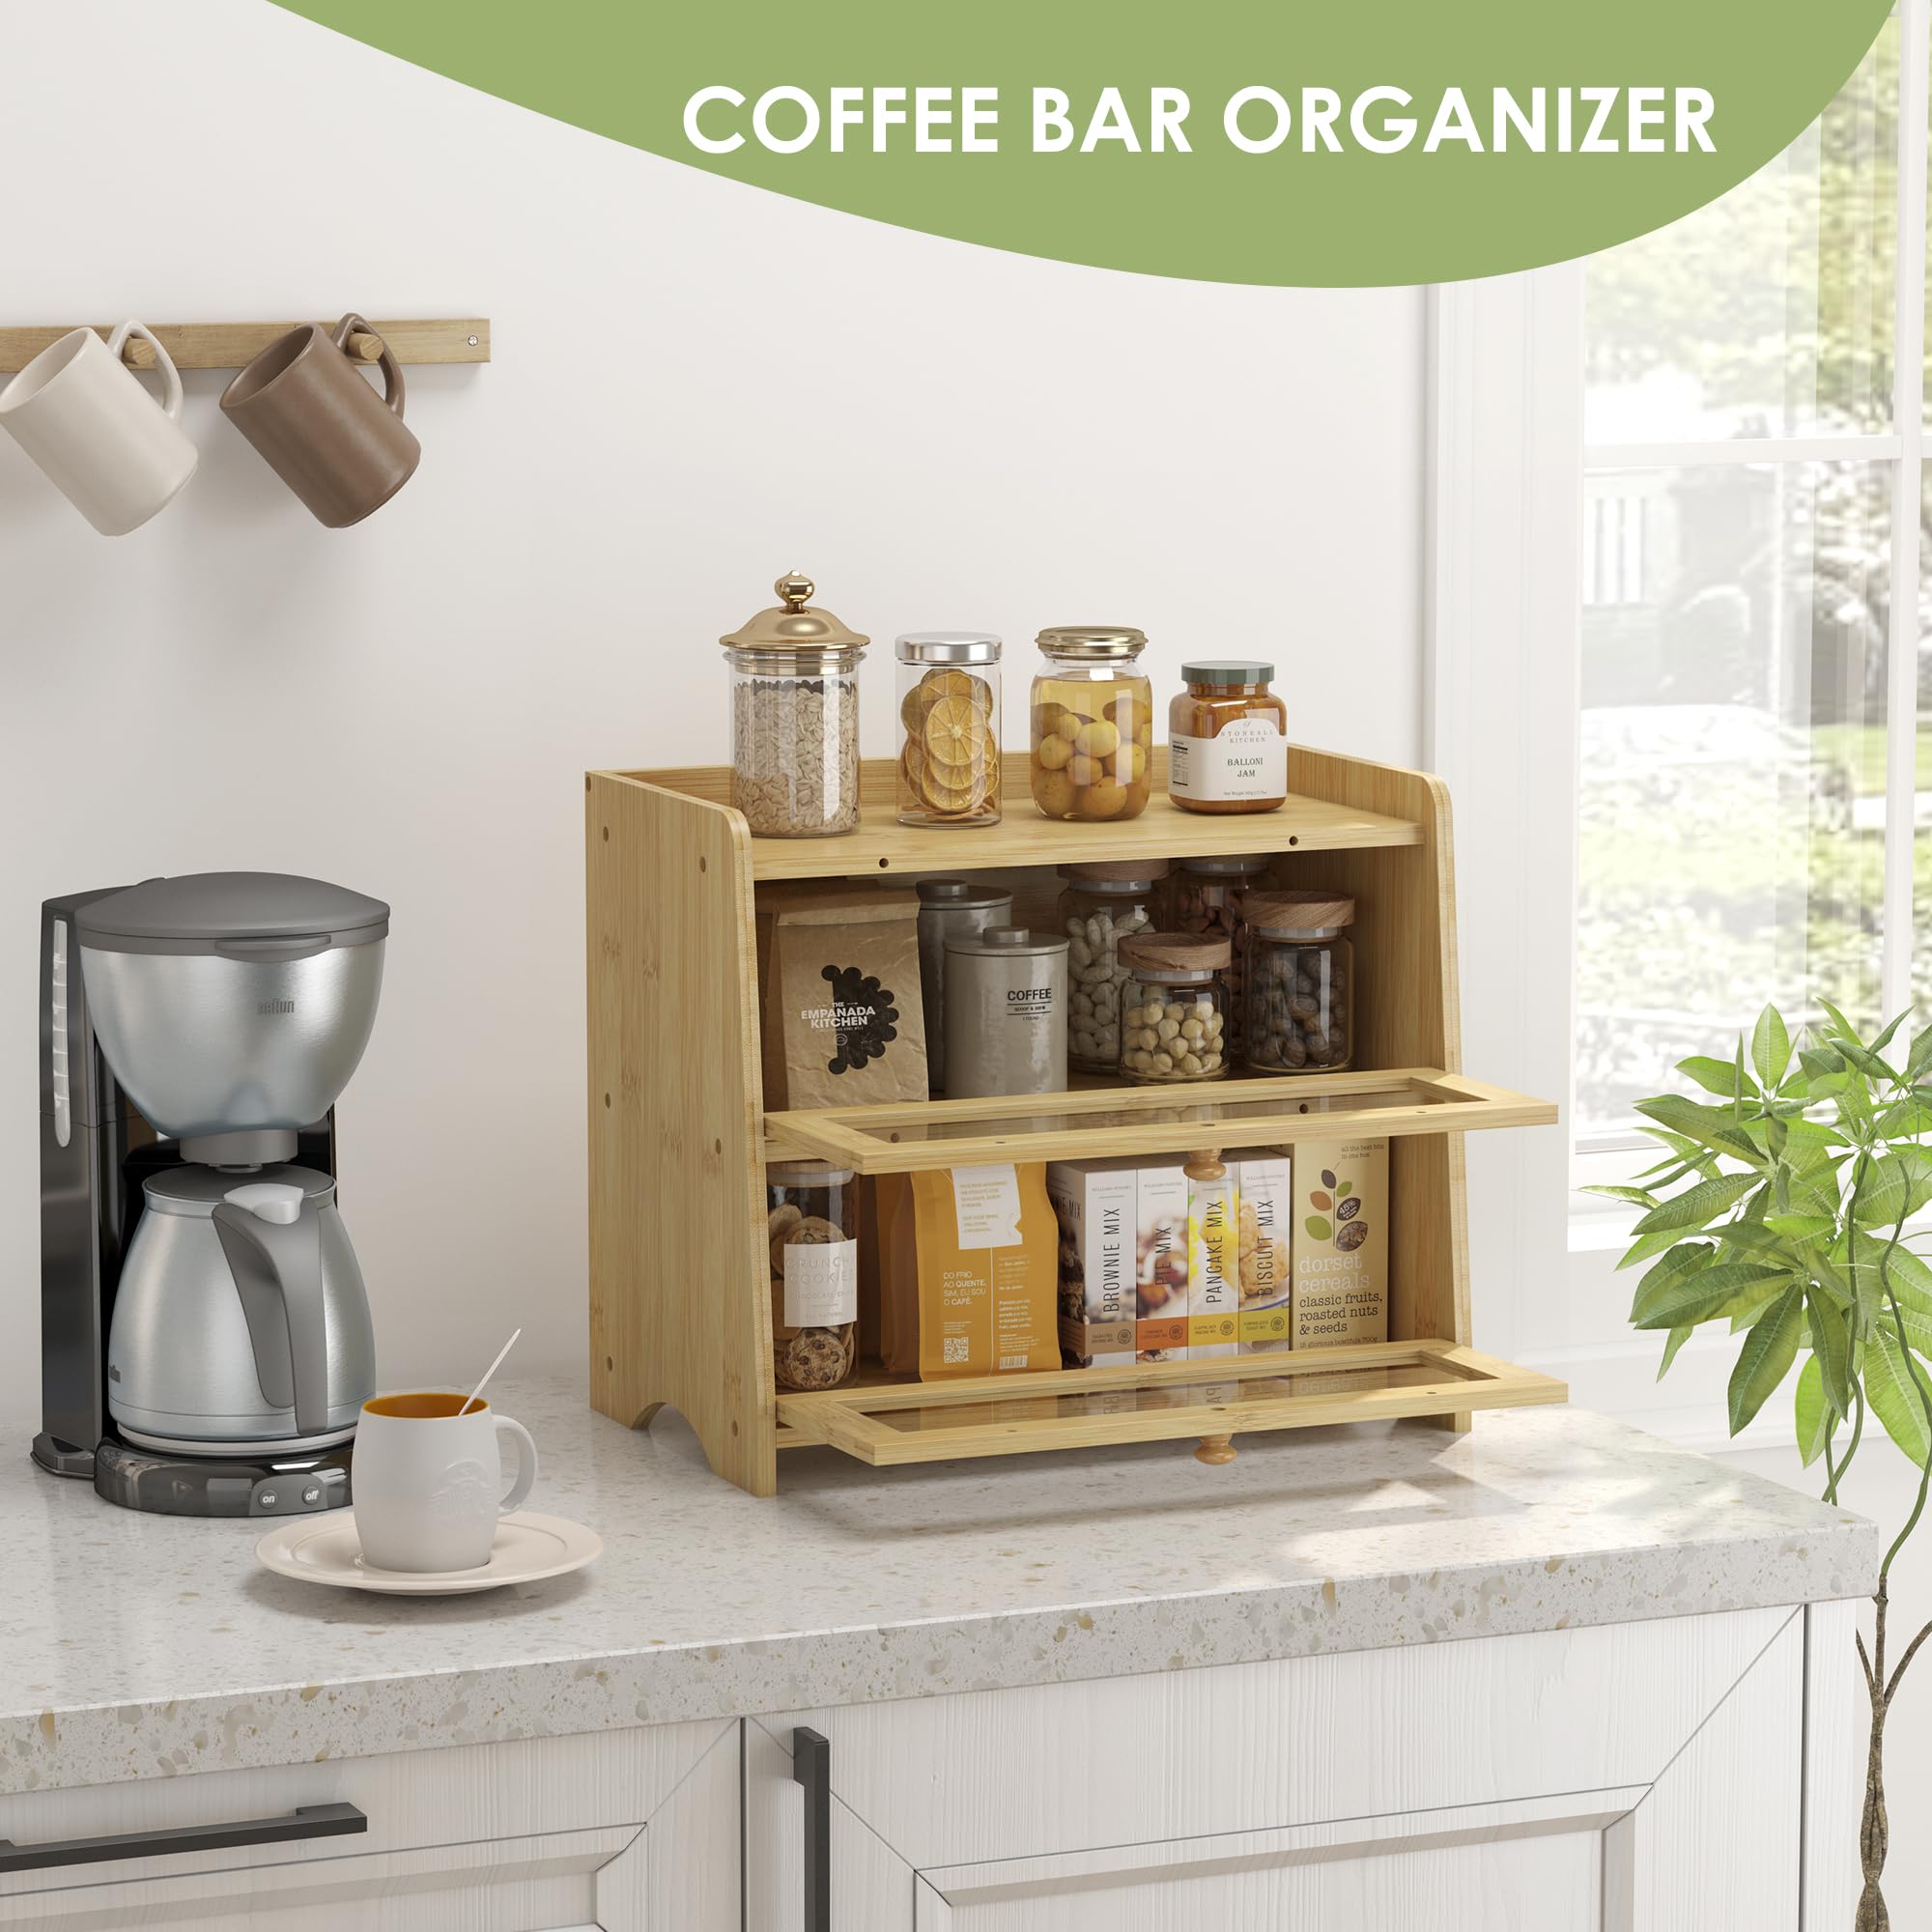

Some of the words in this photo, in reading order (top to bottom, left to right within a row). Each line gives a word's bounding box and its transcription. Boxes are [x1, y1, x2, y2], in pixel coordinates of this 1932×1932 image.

[1227, 757, 1264, 766] BALLONI
[1007, 988, 1052, 1001] COFFEE
[801, 1006, 876, 1020] EMPANADA
[811, 1016, 868, 1029] KITCHEN
[1103, 1208, 1120, 1235] MIX
[1207, 1201, 1222, 1228] MIX
[1257, 1200, 1273, 1227] MIX
[1155, 1227, 1171, 1253] MIX
[1155, 1262, 1171, 1285] PIE
[1206, 1236, 1222, 1303] PANCAKE
[1257, 1236, 1273, 1295] BISCUIT
[1298, 1252, 1363, 1274] dorset
[1103, 1243, 1120, 1312] BROWNIE
[1298, 1272, 1370, 1293] cereals
[1299, 1294, 1342, 1308] classic
[1299, 1307, 1347, 1321] roasted
[1350, 1306, 1378, 1318] nuts
[1299, 1324, 1311, 1335] &
[1313, 1321, 1348, 1334] seeds
[305, 1490, 319, 1500] off
